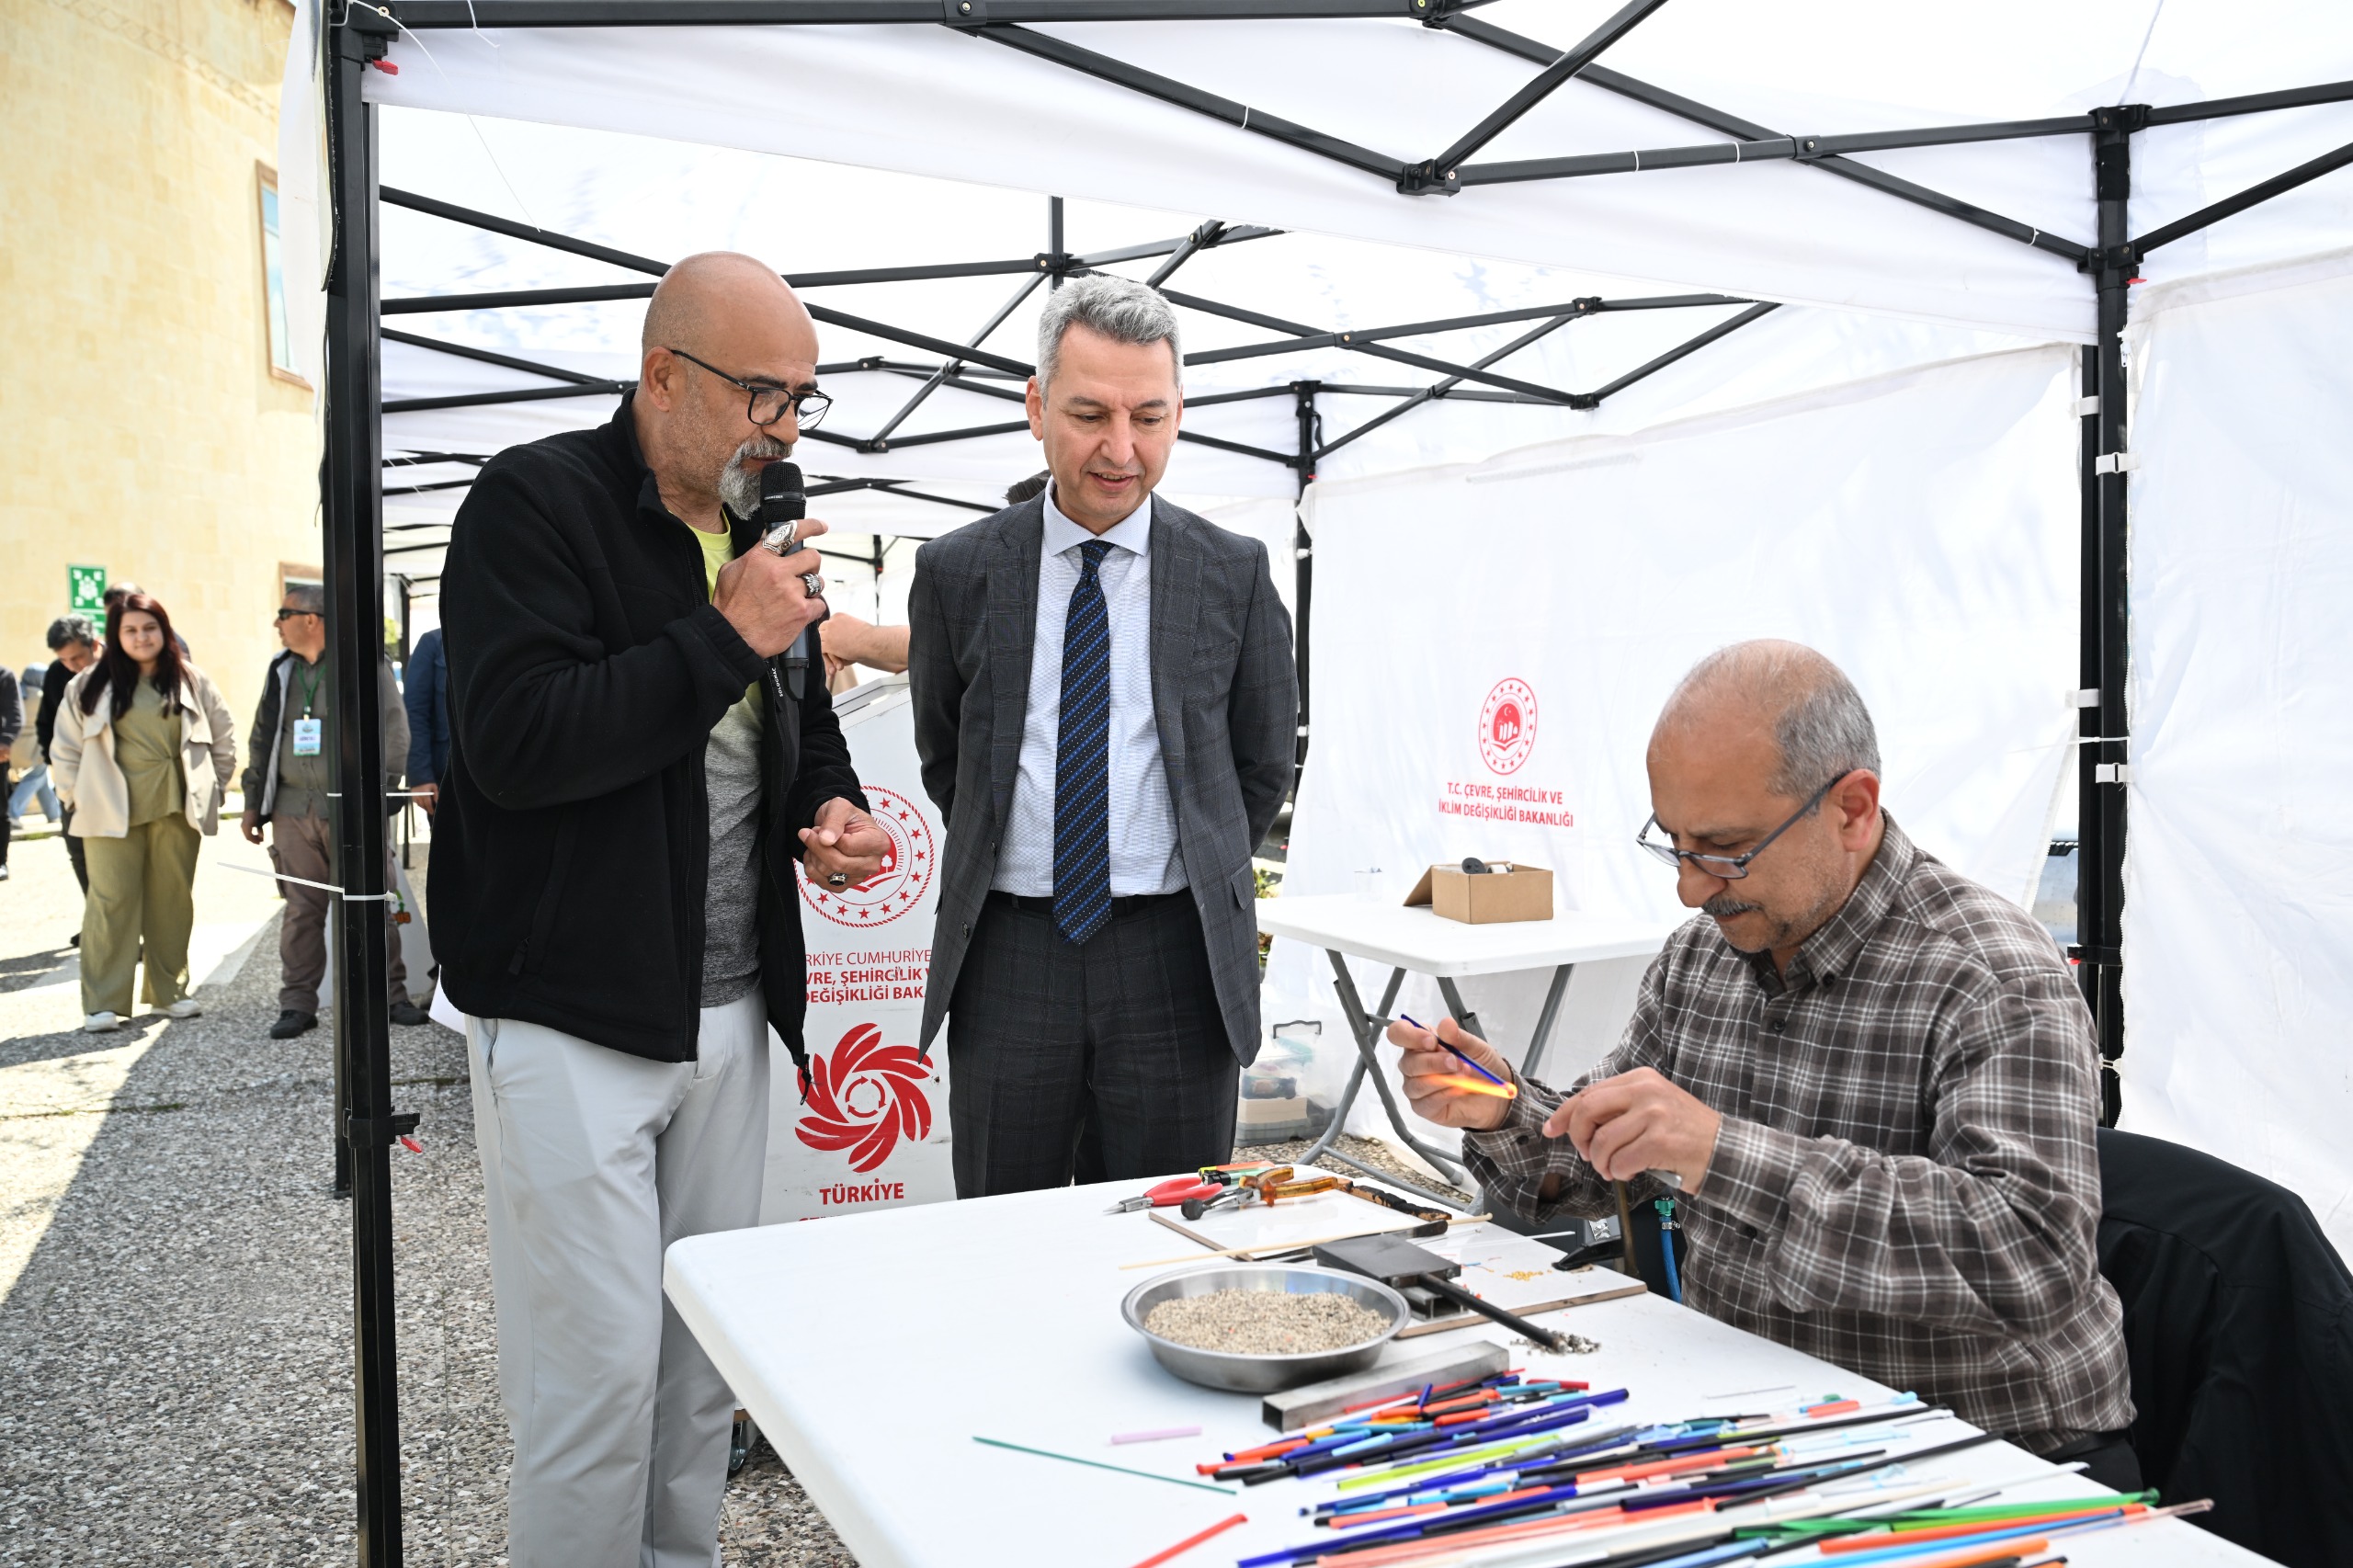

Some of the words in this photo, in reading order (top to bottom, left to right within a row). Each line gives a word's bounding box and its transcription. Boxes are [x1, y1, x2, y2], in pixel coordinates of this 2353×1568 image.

[1447, 782, 1462, 795] T.C.
[1464, 784, 1495, 800] ÇEVRE,
[1496, 785, 1548, 803] ŞEHİRCİLİK
[1550, 790, 1563, 805] VE
[1438, 798, 1461, 815] İKLİM
[1463, 802, 1517, 822] DEĞİŞİKLİĞİ
[1518, 810, 1574, 827] BAKANLIĞI
[805, 950, 843, 967] RKİYE
[847, 948, 932, 965] CUMHURİYE
[806, 971, 836, 986] VRE,
[840, 965, 923, 987] ŞEHİRCİLİK
[892, 985, 926, 1000] BAK
[819, 1177, 904, 1206] TÜRKİYE
